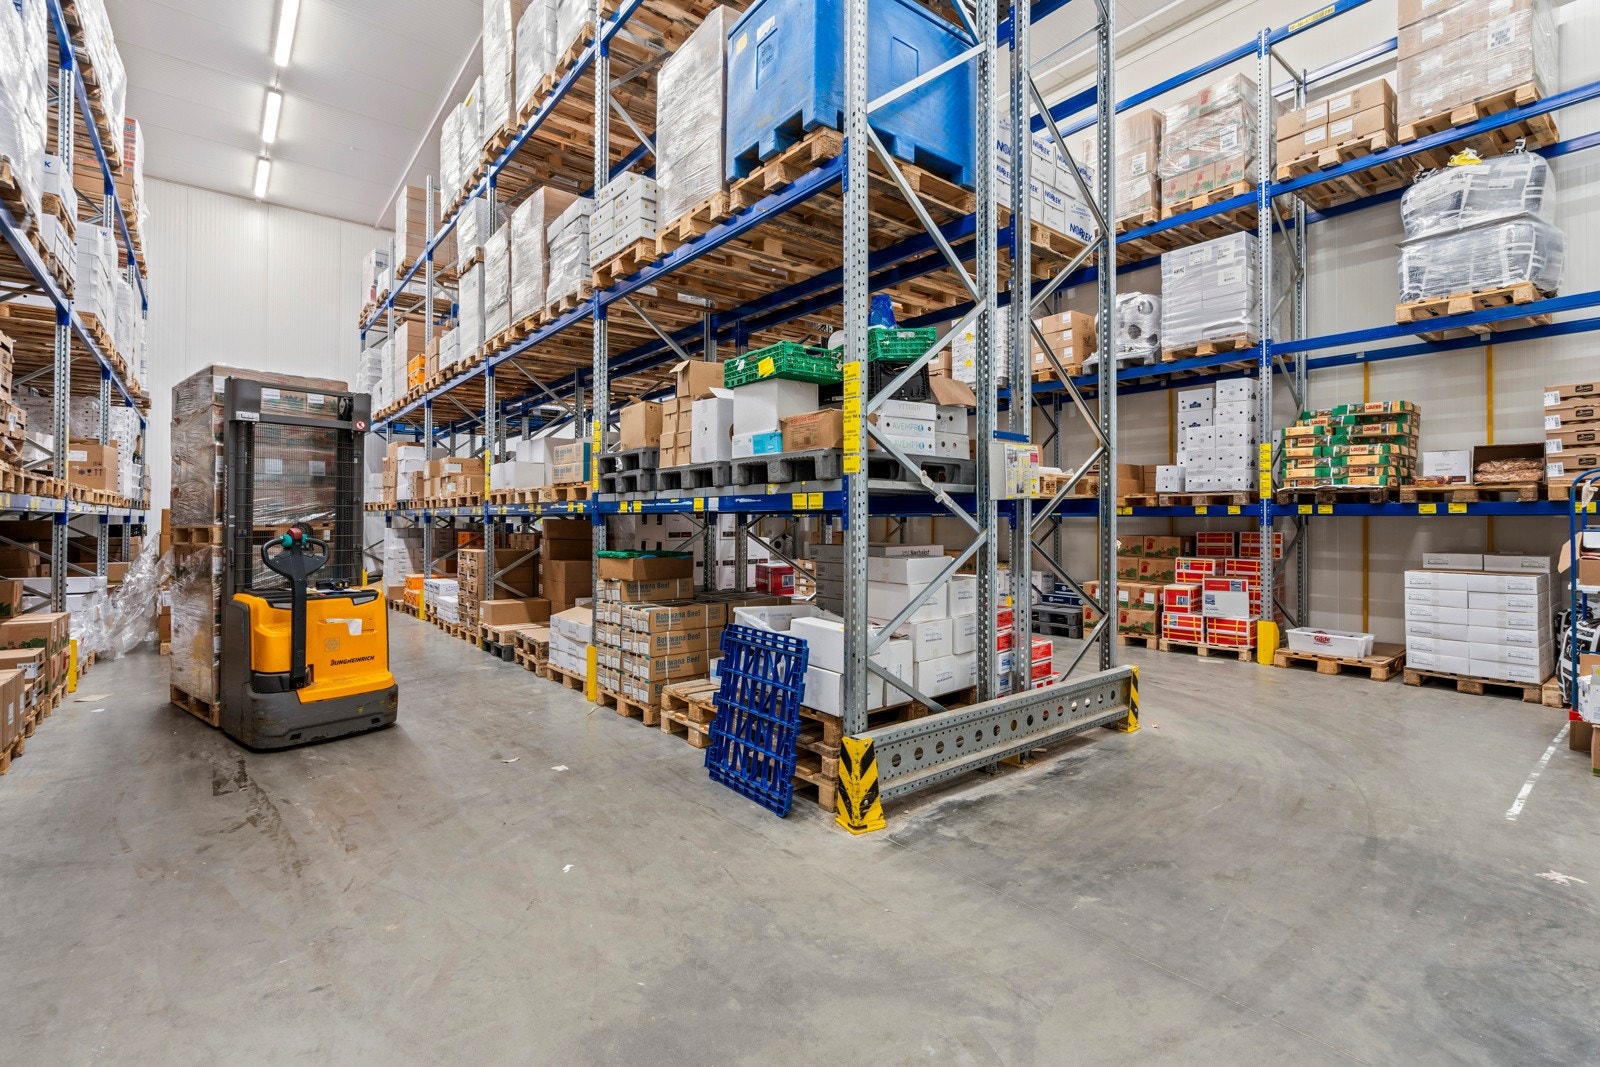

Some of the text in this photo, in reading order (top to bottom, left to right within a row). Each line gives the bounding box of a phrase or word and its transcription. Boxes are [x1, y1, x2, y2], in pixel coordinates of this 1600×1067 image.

[1069, 222, 1093, 242] NORREK
[627, 581, 670, 591] Botwana Beef
[687, 609, 700, 618] Beef
[657, 632, 700, 644] Botwana Beef
[331, 655, 375, 666] JUNGHEINRICH
[656, 655, 700, 668] Botwana Beef
